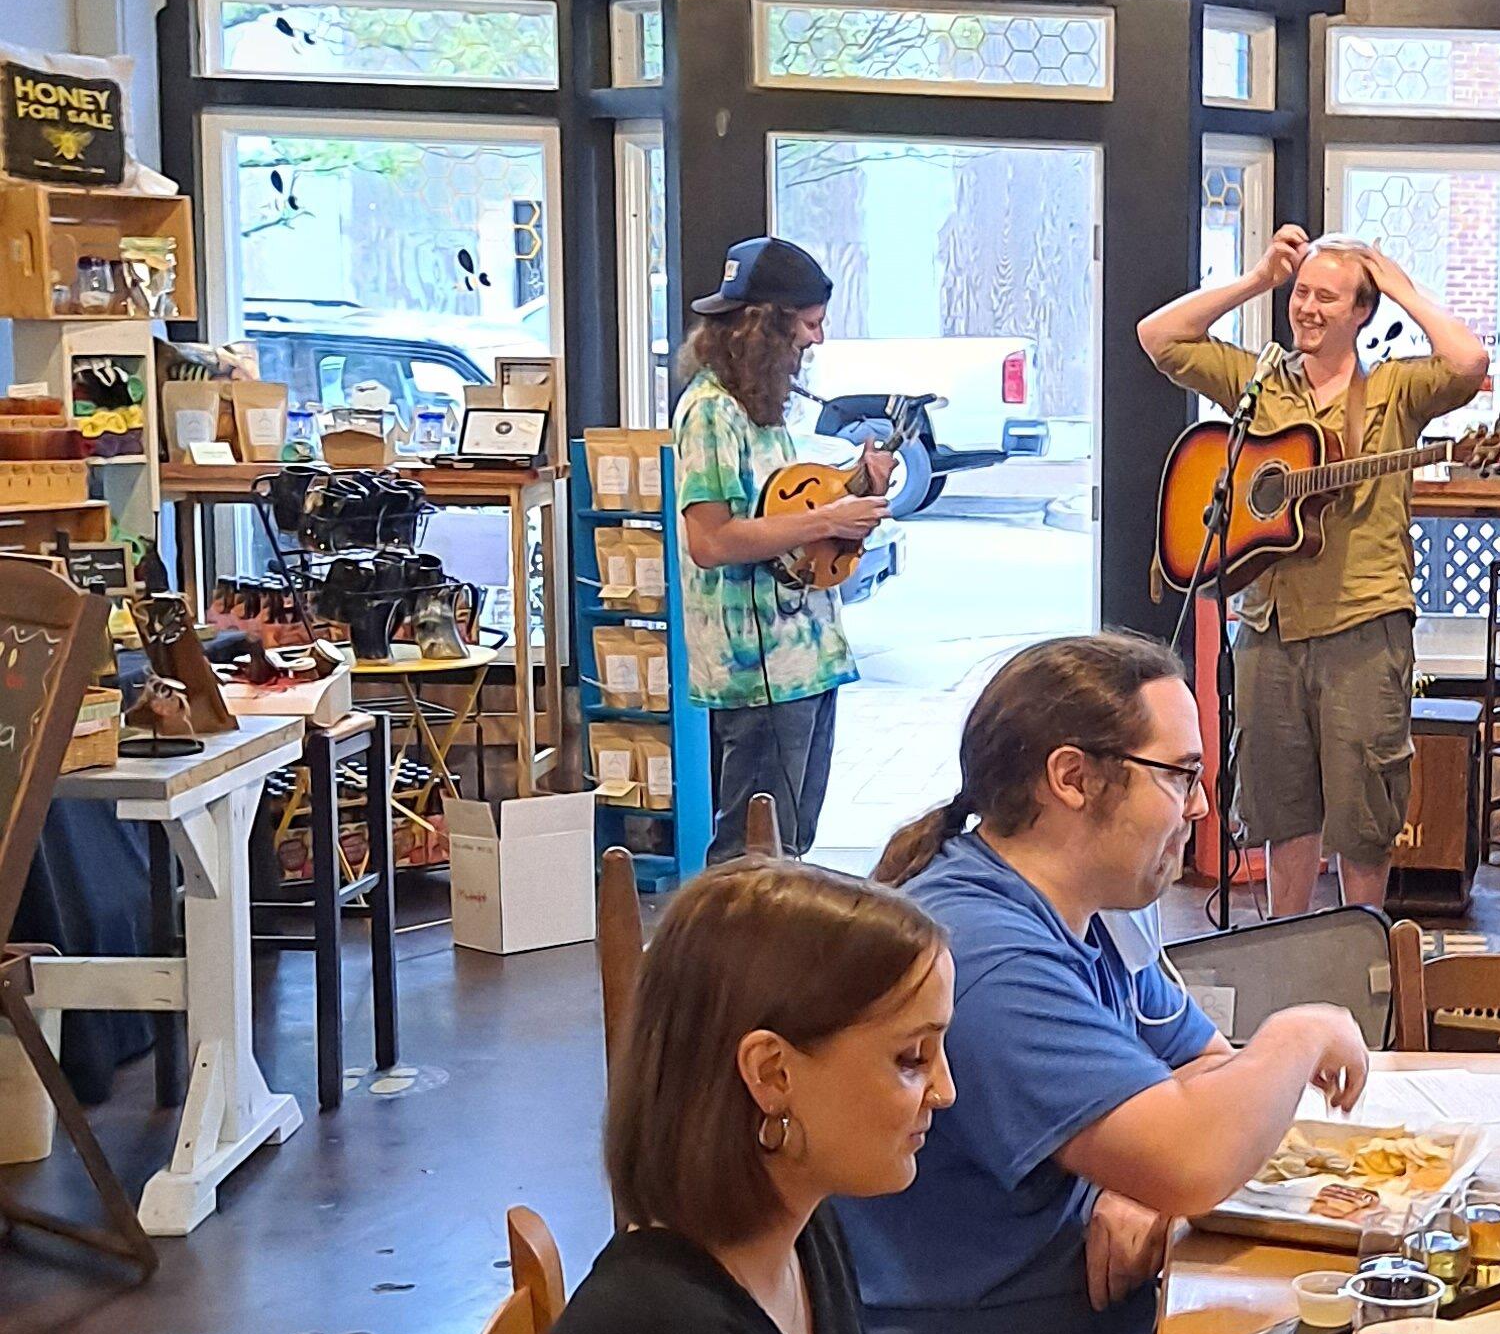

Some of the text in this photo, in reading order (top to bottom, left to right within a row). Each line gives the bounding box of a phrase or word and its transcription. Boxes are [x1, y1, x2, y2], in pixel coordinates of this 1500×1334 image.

[14, 75, 111, 111] HONEY
[16, 100, 115, 131] FOR SALE
